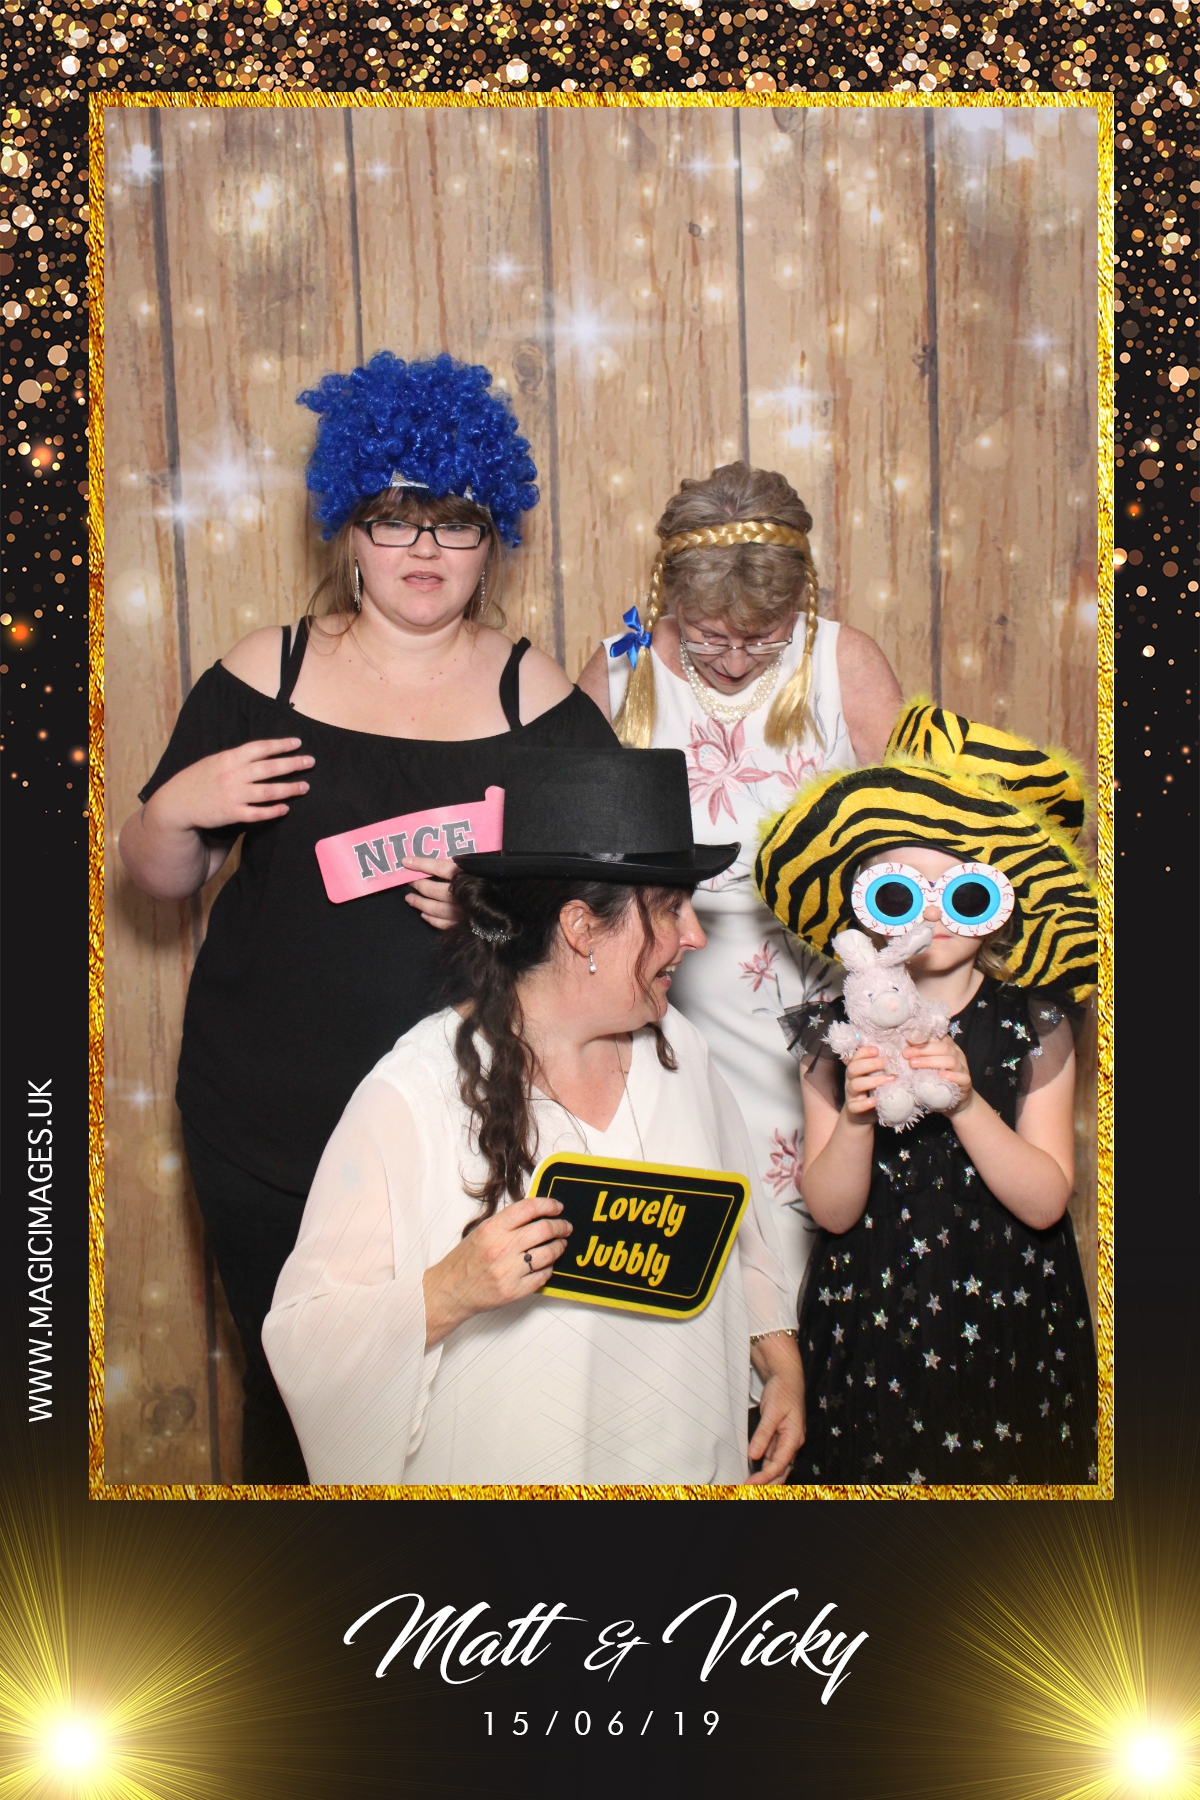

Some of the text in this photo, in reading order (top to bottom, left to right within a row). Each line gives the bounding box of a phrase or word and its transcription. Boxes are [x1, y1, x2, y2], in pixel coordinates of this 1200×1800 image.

[352, 819, 477, 879] NICE
[592, 1190, 687, 1238] Lovely
[575, 1235, 671, 1287] Jubbly
